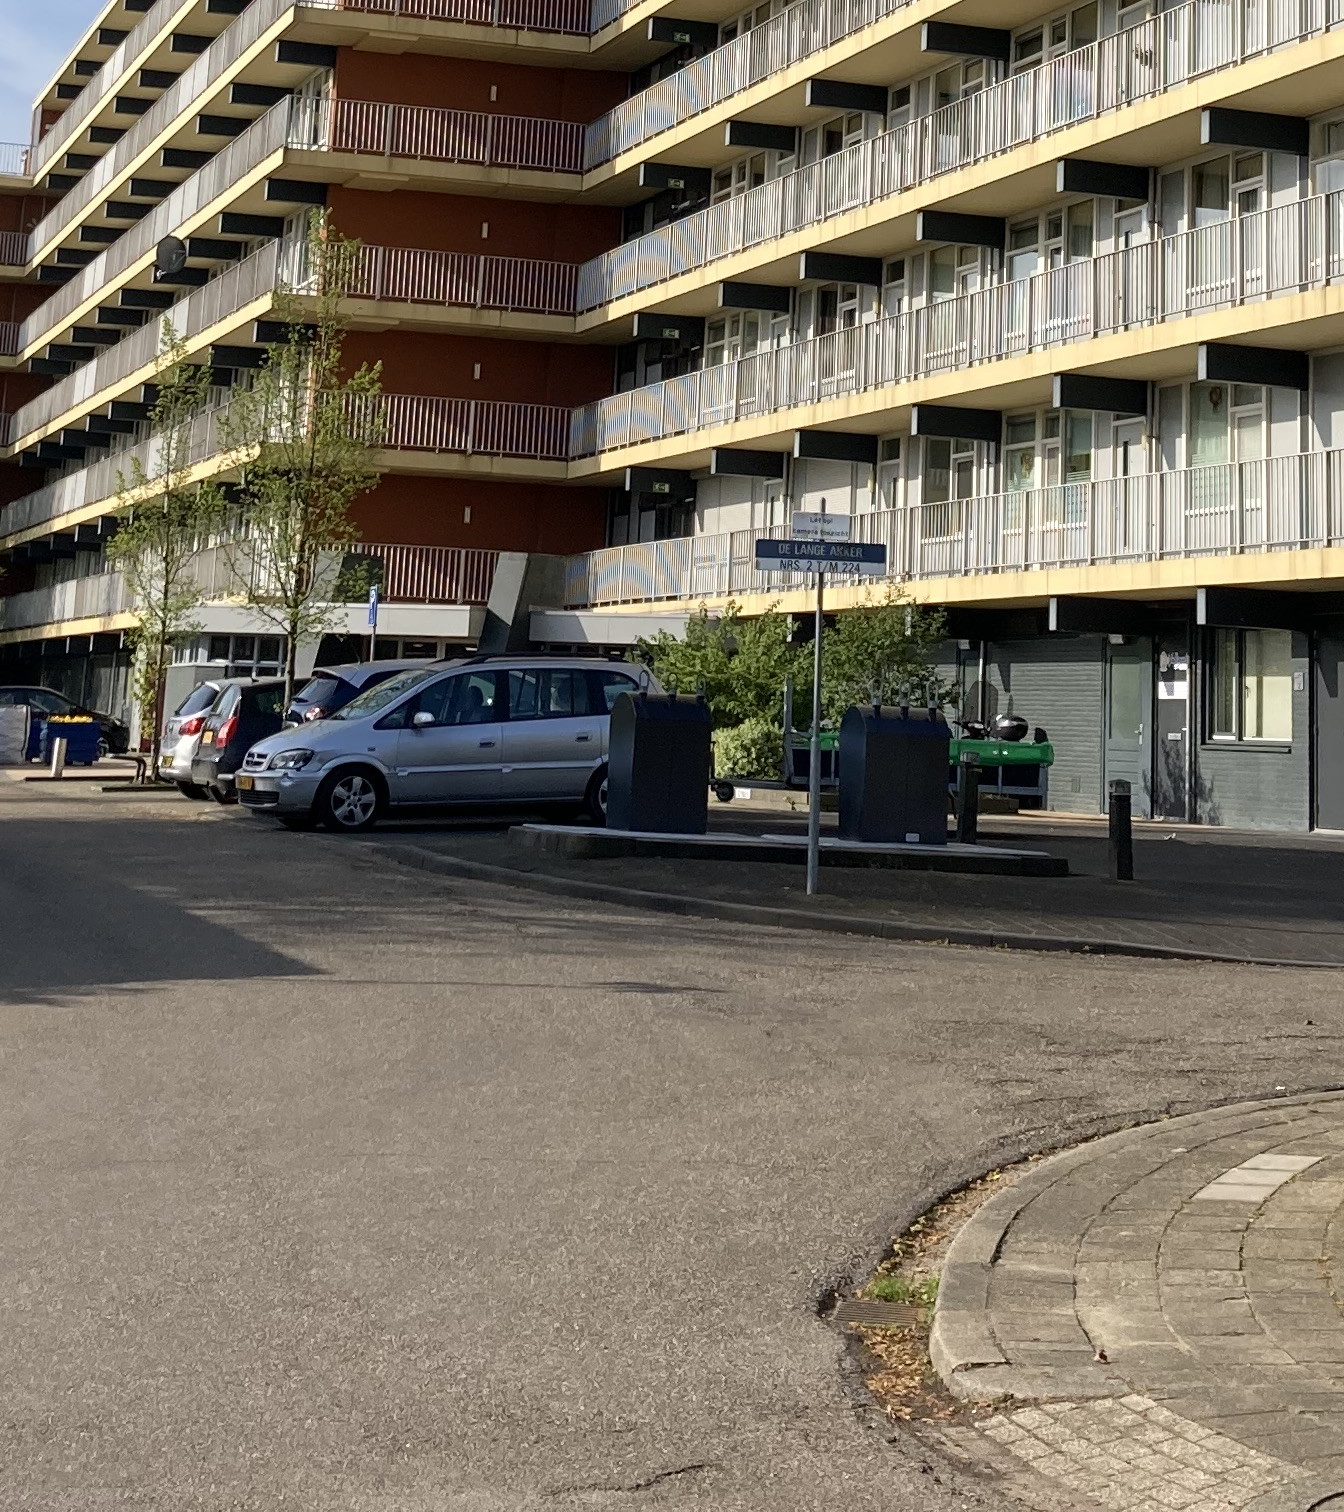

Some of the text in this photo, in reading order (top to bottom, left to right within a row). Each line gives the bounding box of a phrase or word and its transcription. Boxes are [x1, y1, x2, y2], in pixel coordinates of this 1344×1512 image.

[778, 543, 863, 558] DE LANGE AKKER
[806, 560, 813, 572] 2
[816, 561, 839, 574] T/M
[842, 562, 861, 574] 224
